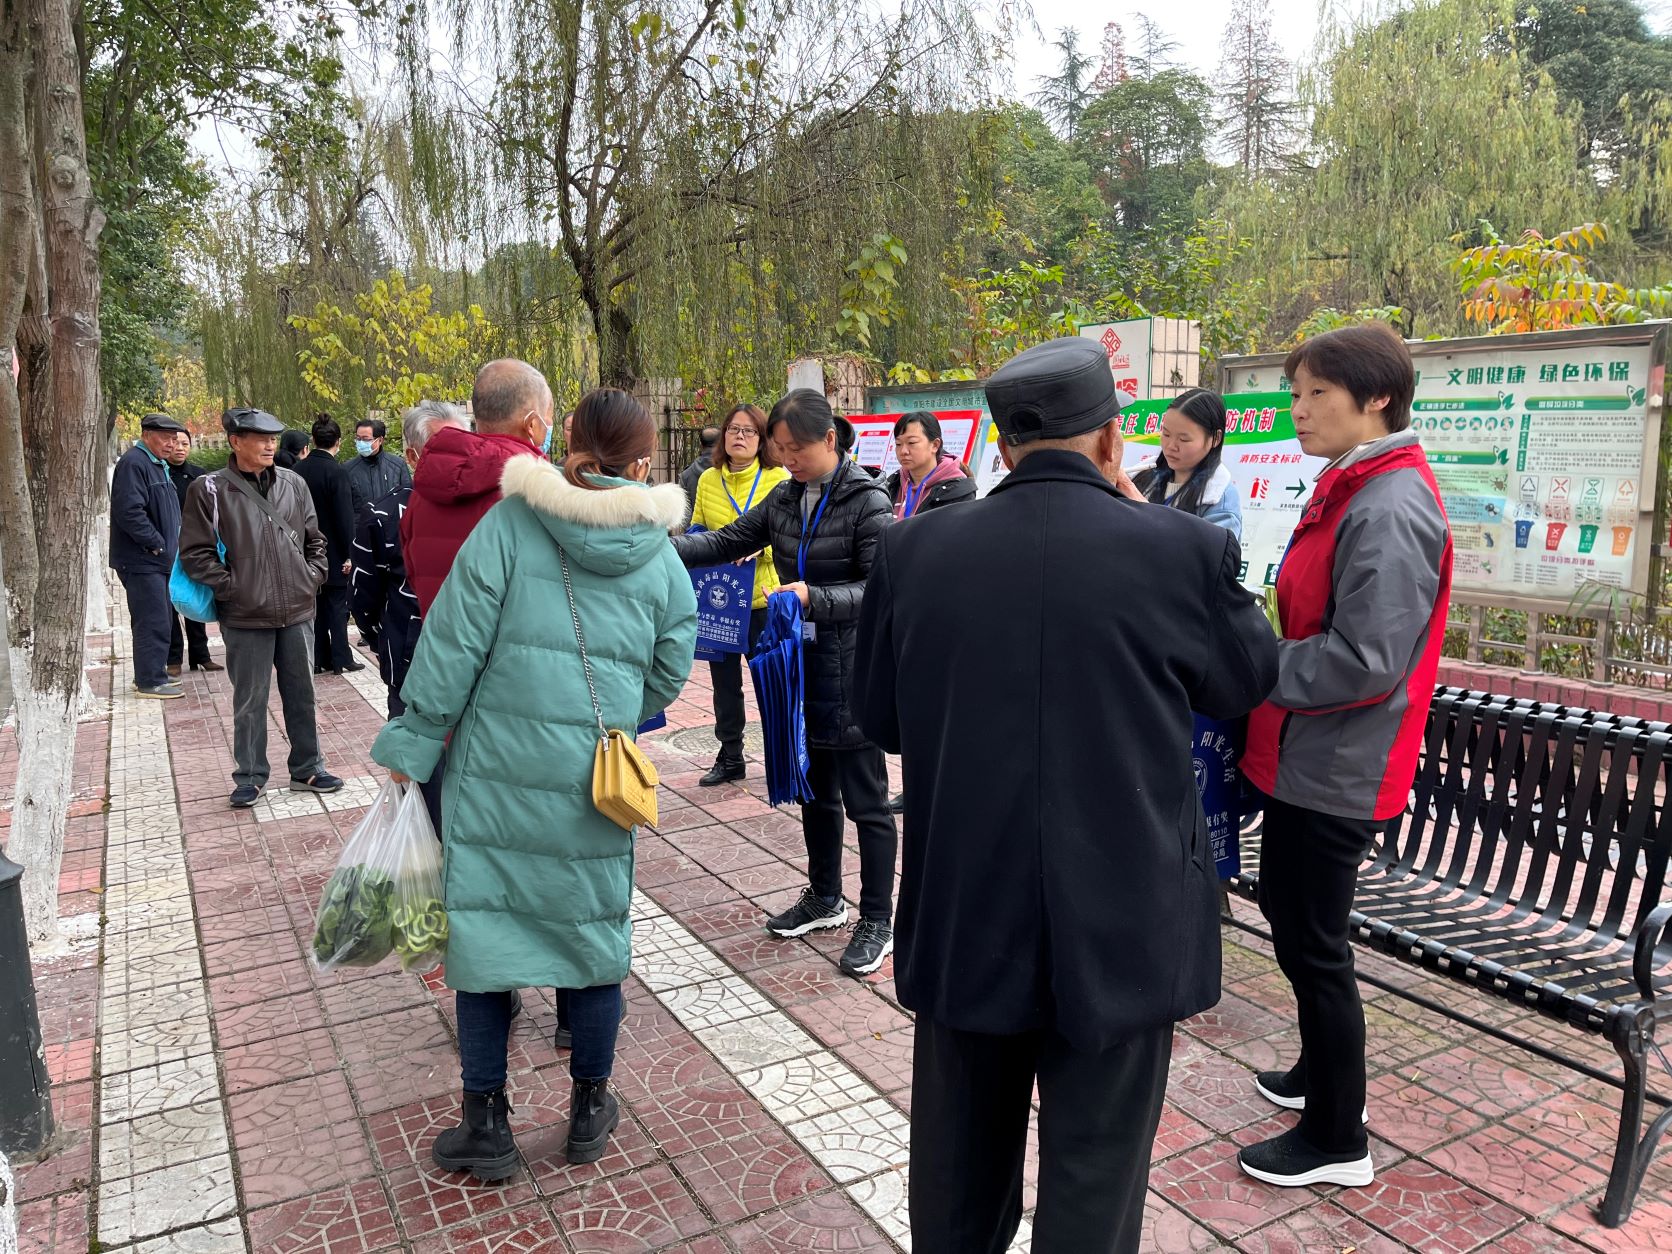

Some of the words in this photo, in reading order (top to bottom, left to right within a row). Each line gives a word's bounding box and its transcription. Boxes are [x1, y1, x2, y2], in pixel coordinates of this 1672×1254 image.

[1539, 361, 1630, 383] 绿色环保
[1225, 408, 1277, 433] 防机制
[1240, 454, 1302, 464] 消防安全标识
[1201, 731, 1236, 783] 阳光生活
